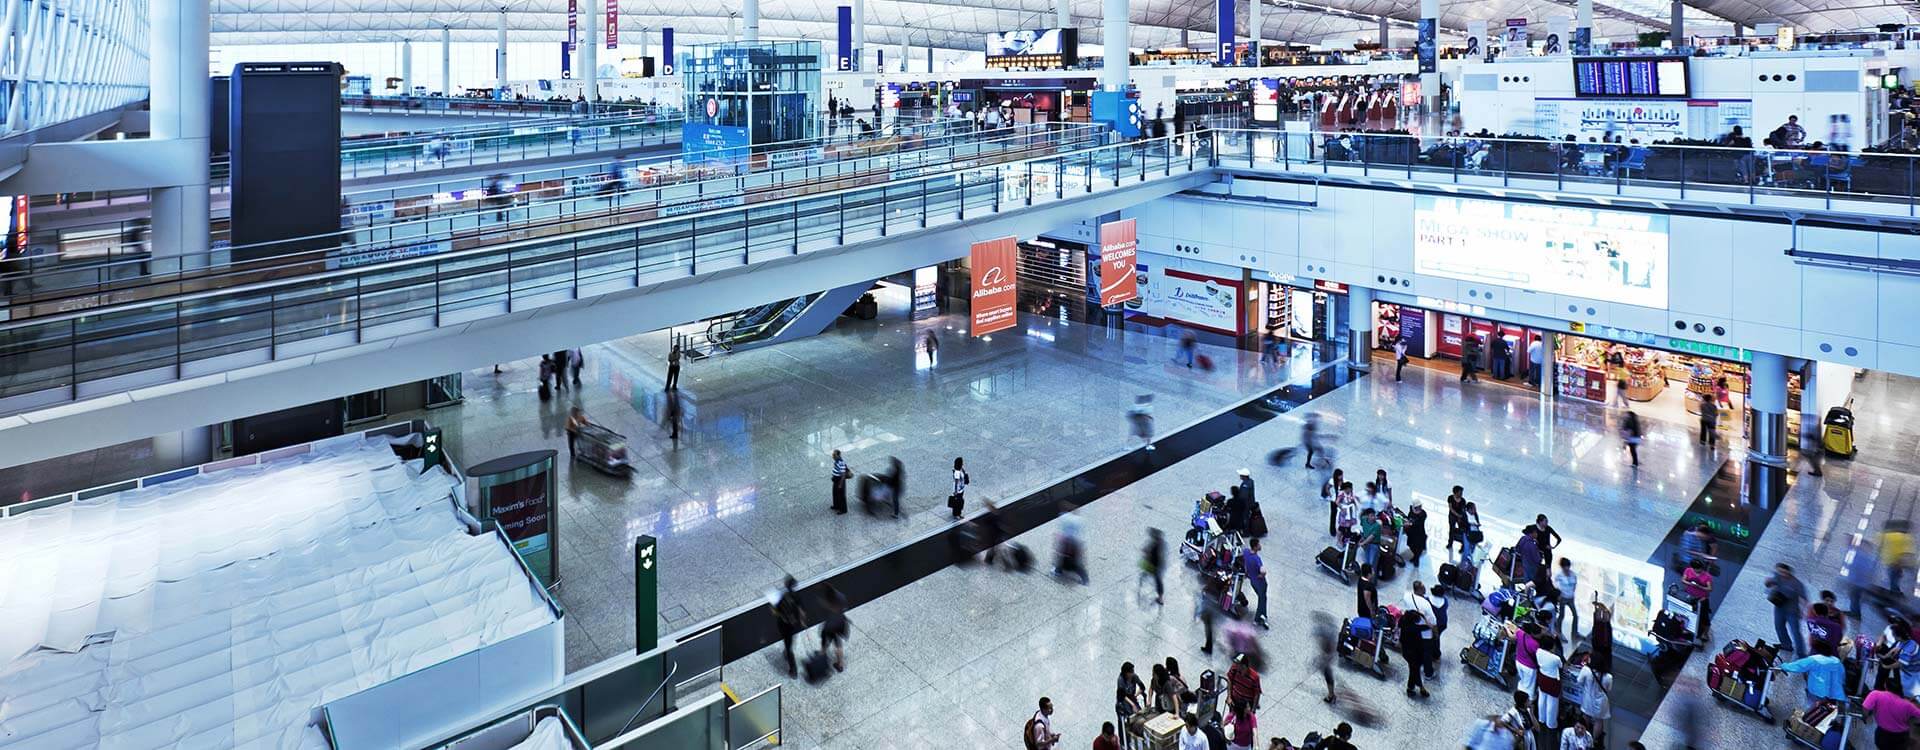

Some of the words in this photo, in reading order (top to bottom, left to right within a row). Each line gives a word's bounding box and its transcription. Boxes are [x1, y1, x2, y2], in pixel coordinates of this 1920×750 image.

[1222, 42, 1231, 60] F
[840, 57, 848, 69] E
[562, 70, 570, 79] C
[664, 65, 673, 75] D
[1420, 233, 1453, 246] PART
[1102, 247, 1136, 262] WELCOMES
[1113, 260, 1126, 270] YOU
[973, 283, 1016, 299] Alibaba.com
[492, 500, 525, 515] Maxim's
[526, 513, 546, 524] Soon
